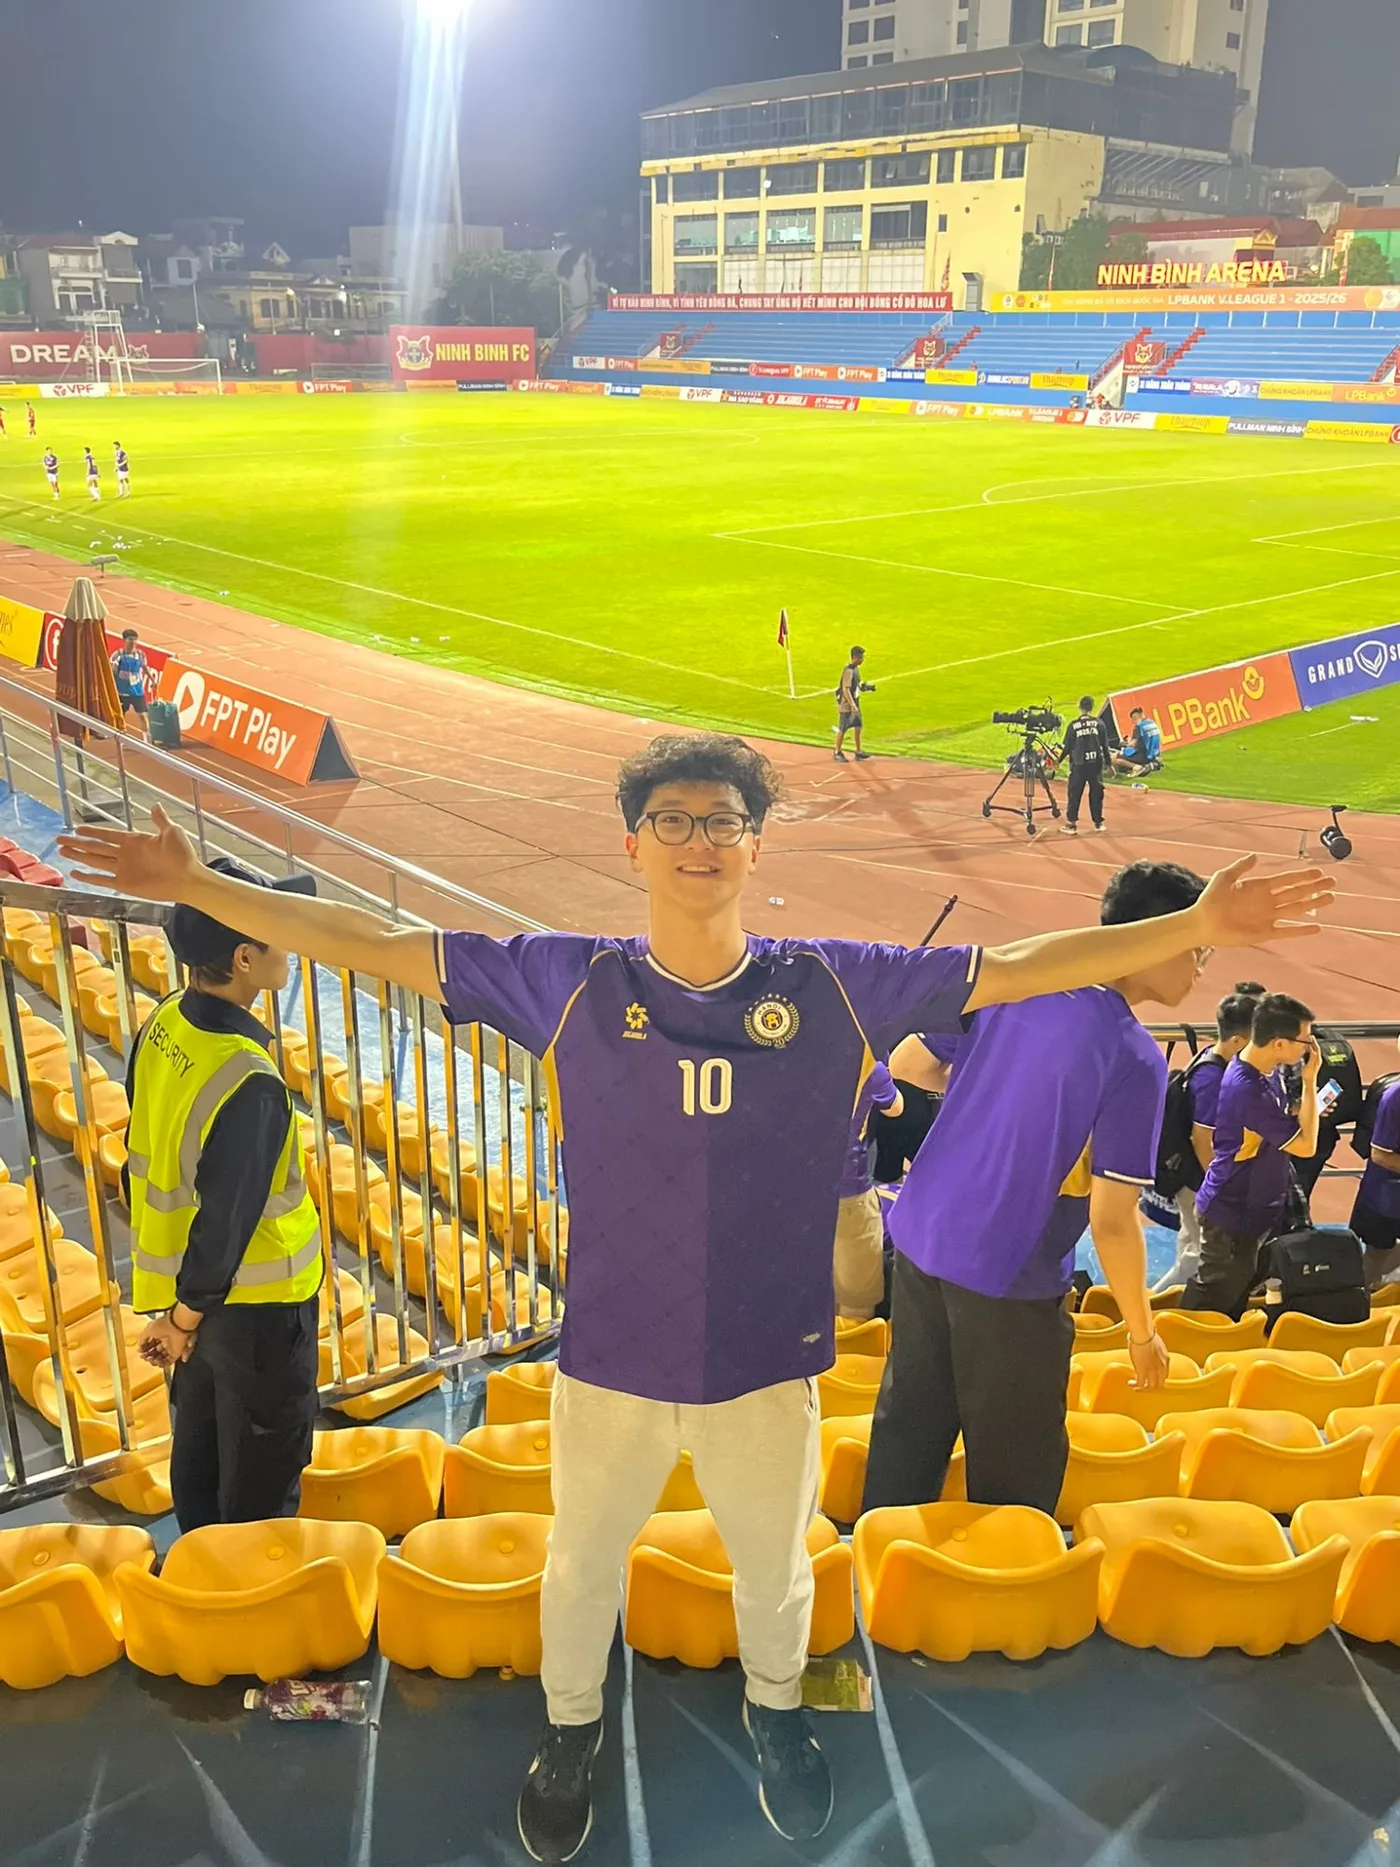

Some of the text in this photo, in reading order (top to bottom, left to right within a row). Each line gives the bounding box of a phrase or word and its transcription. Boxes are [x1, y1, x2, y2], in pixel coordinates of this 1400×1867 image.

[1097, 258, 1287, 284] NINH BÌNH ARENA
[838, 297, 853, 308] CHO
[917, 296, 934, 308] HOA
[1168, 294, 1215, 304] LPBANK
[1218, 294, 1277, 304] V.LEAGUE
[1279, 294, 1286, 304] 1
[1294, 292, 1348, 304] 2025/26
[10, 344, 118, 363] DREAM
[435, 343, 530, 361] NINH BINH FC
[803, 367, 828, 379] FPT Play
[847, 368, 873, 380] FPT Play
[66, 384, 94, 393] VPF
[314, 383, 346, 393] FPT Play
[529, 381, 560, 391] FPT Play
[696, 389, 713, 397] VPF
[926, 403, 960, 416] FPT Play
[1114, 412, 1141, 423] VPF
[1229, 422, 1266, 432] PULLMAN
[1308, 656, 1354, 684] GRAND
[1152, 687, 1251, 745] LPBank
[200, 690, 297, 770] FPT Play
[758, 1004, 781, 1015] HANOI
[149, 1022, 195, 1078] SECURITY
[678, 1057, 733, 1116] 10
